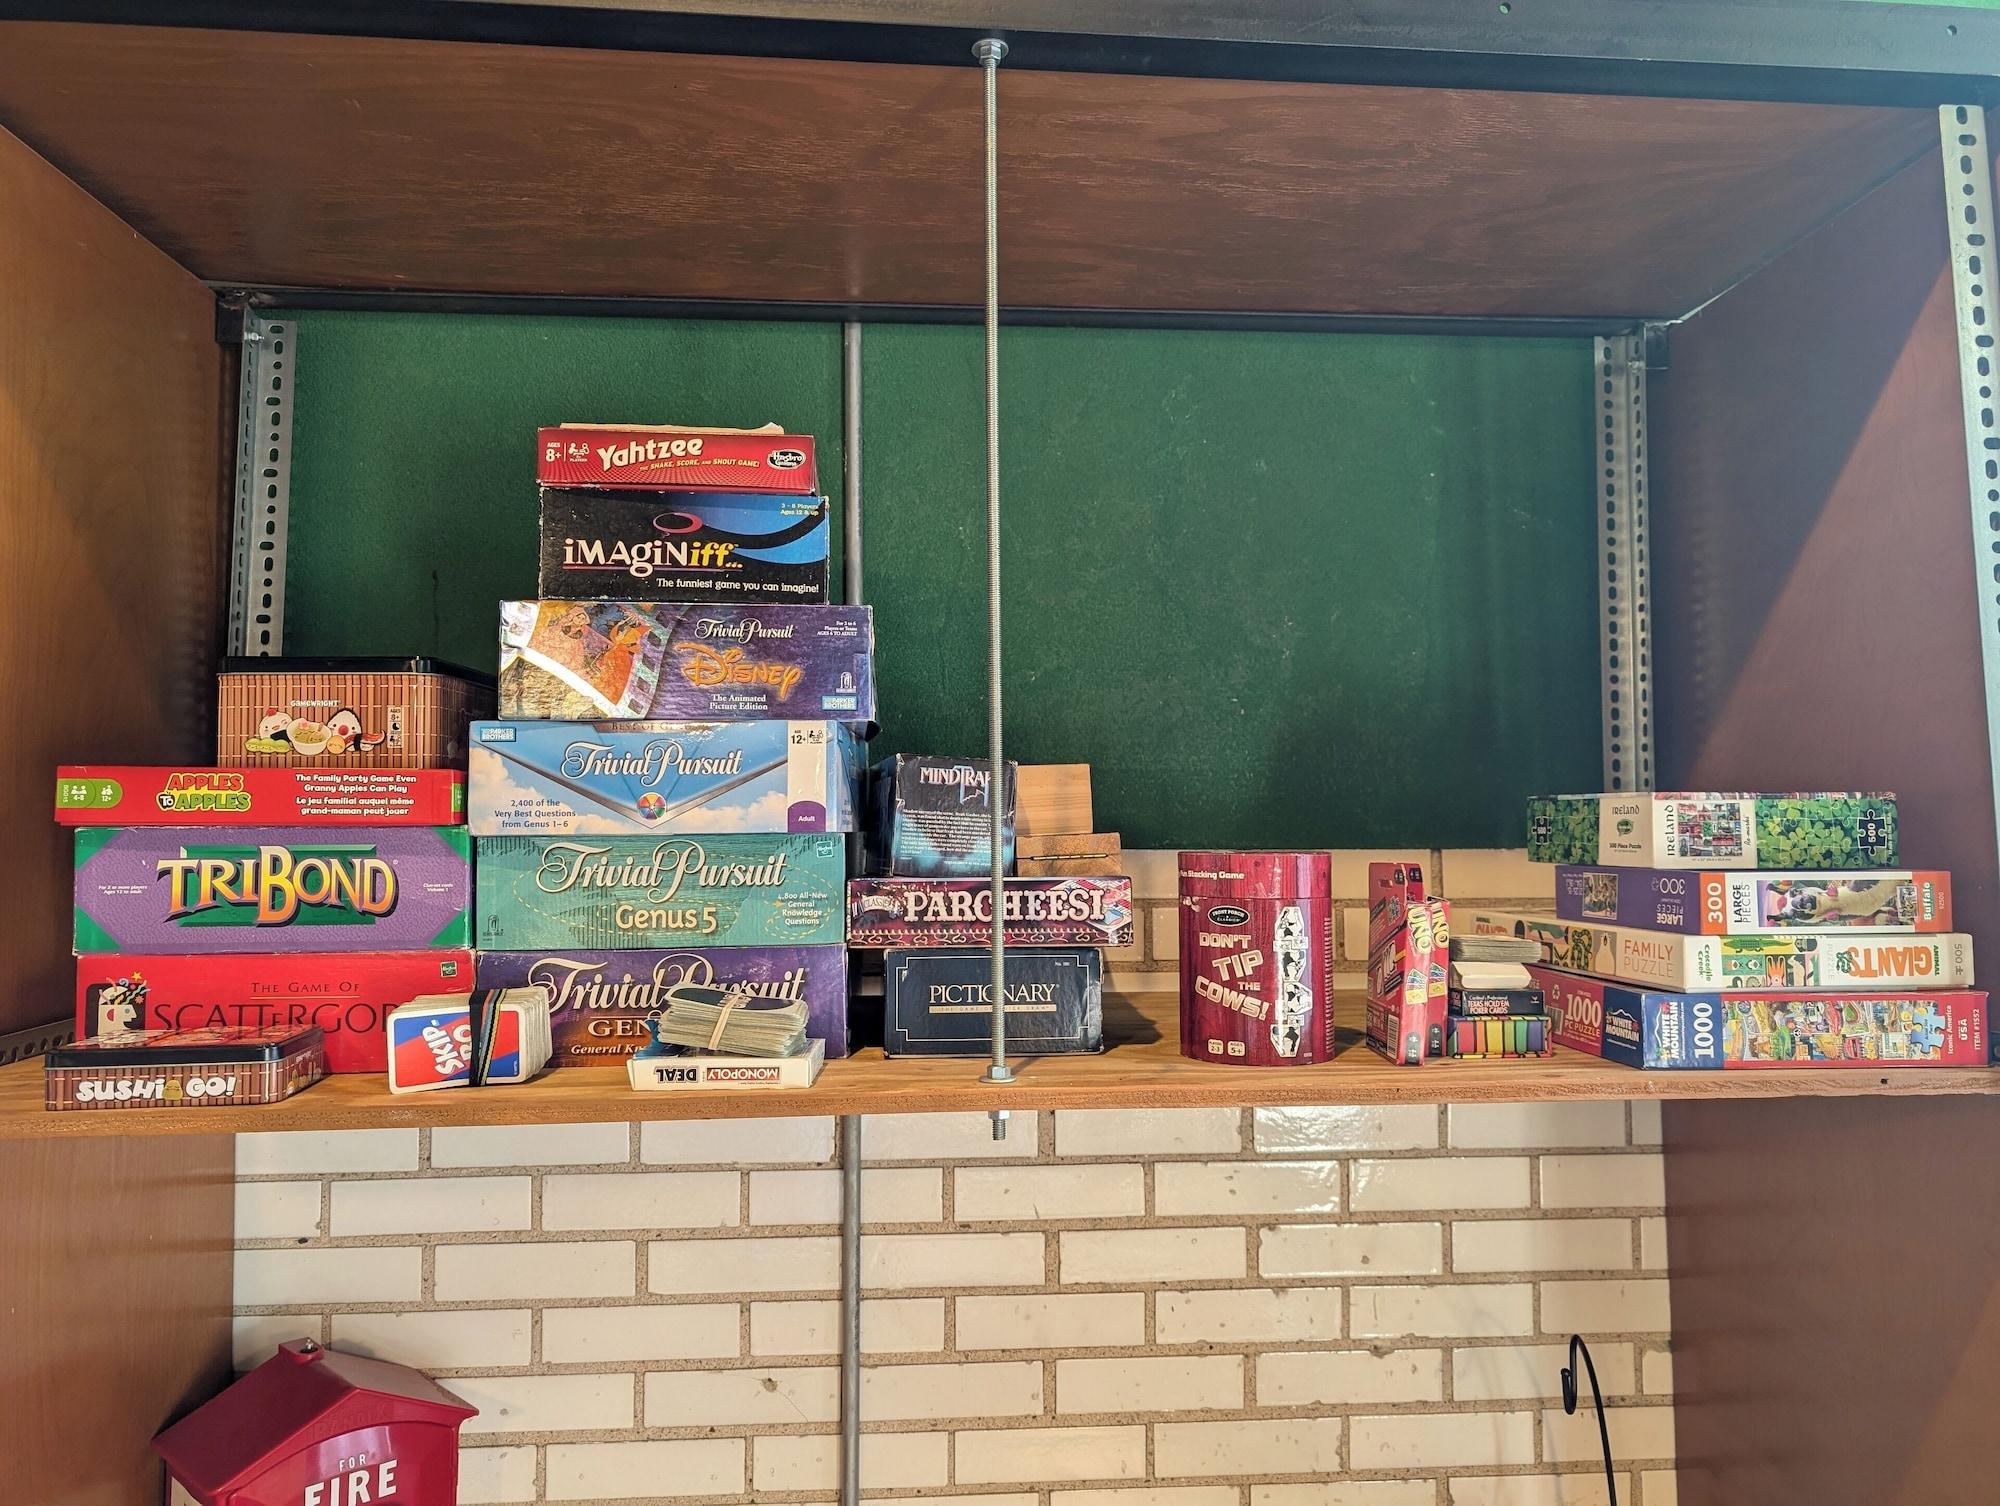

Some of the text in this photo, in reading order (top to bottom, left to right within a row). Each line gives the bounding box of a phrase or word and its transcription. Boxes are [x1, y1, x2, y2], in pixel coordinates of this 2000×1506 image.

[546, 449, 561, 461] 8+
[597, 438, 703, 471] Yahtzee
[773, 451, 803, 461] Hasbro
[651, 462, 675, 470] SHAKE,
[738, 459, 760, 467] GAME!
[656, 578, 819, 594] The funniest game you can imagine!
[694, 618, 794, 643] Trivial Pursuit
[709, 702, 768, 711] Picture Edition
[712, 694, 766, 703] The Animated
[791, 735, 806, 744] 12+
[561, 739, 743, 787] Trivial Pursuit
[168, 774, 241, 791] APPLES
[296, 774, 311, 782] The
[313, 774, 341, 783] Family
[343, 774, 369, 783] Party
[304, 784, 336, 793] Granny
[338, 785, 368, 794] Apples
[388, 785, 408, 793] Play
[175, 794, 250, 810] APPLES
[307, 797, 322, 806] jeu
[324, 796, 356, 805] familial
[359, 797, 388, 806] auquel
[511, 799, 560, 808] 2,400 of the
[301, 807, 409, 816] grand-maman peut jouer
[494, 810, 512, 819] Very
[535, 810, 576, 818] Questions
[502, 820, 550, 828] from Genus
[1868, 822, 1877, 843] 500
[536, 839, 786, 904] Trivial Pursuit
[1188, 871, 1245, 880] Stacking Game
[157, 845, 396, 925] TRIBOND
[1659, 878, 1685, 894] 300
[1656, 905, 1684, 914] PIECES
[1707, 882, 1722, 923] 300
[1733, 883, 1742, 923] LARGE
[1742, 883, 1751, 923] PIECES
[1923, 882, 1932, 920] Buffalo
[615, 904, 718, 933] Genus 5
[782, 909, 822, 917] Knowledge
[1656, 913, 1684, 925] LARGE
[1407, 905, 1432, 954] UNO
[1199, 932, 1251, 949] DON'T
[1624, 940, 1674, 961] FAMILY
[1212, 949, 1264, 982] TIP
[1624, 956, 1674, 978] PUZZLE
[1697, 951, 1705, 976] Creek
[1704, 943, 1713, 982] Crocodile
[1848, 945, 1933, 977] GIANTS
[251, 982, 360, 993] THE GAME OF
[528, 957, 664, 1014] Trivial
[1238, 981, 1261, 991] THE
[1195, 975, 1270, 1021] COWS!
[1566, 994, 1601, 1028] 1000
[1565, 1020, 1601, 1037] PC PUZZLE
[1612, 1015, 1632, 1026] WHITE
[1960, 1018, 1968, 1040] USA
[1606, 1024, 1640, 1042] MOUNTAIN
[1662, 1014, 1670, 1049] WHITE
[1670, 1002, 1680, 1059] MOUNTAIN
[1692, 1002, 1714, 1058] 1000
[571, 1044, 621, 1055] General
[655, 1067, 780, 1083] DEAL MONOPOLY
[186, 1076, 238, 1100] GO!
[339, 1453, 367, 1471] FOR
[305, 1459, 398, 1506] FIRE
